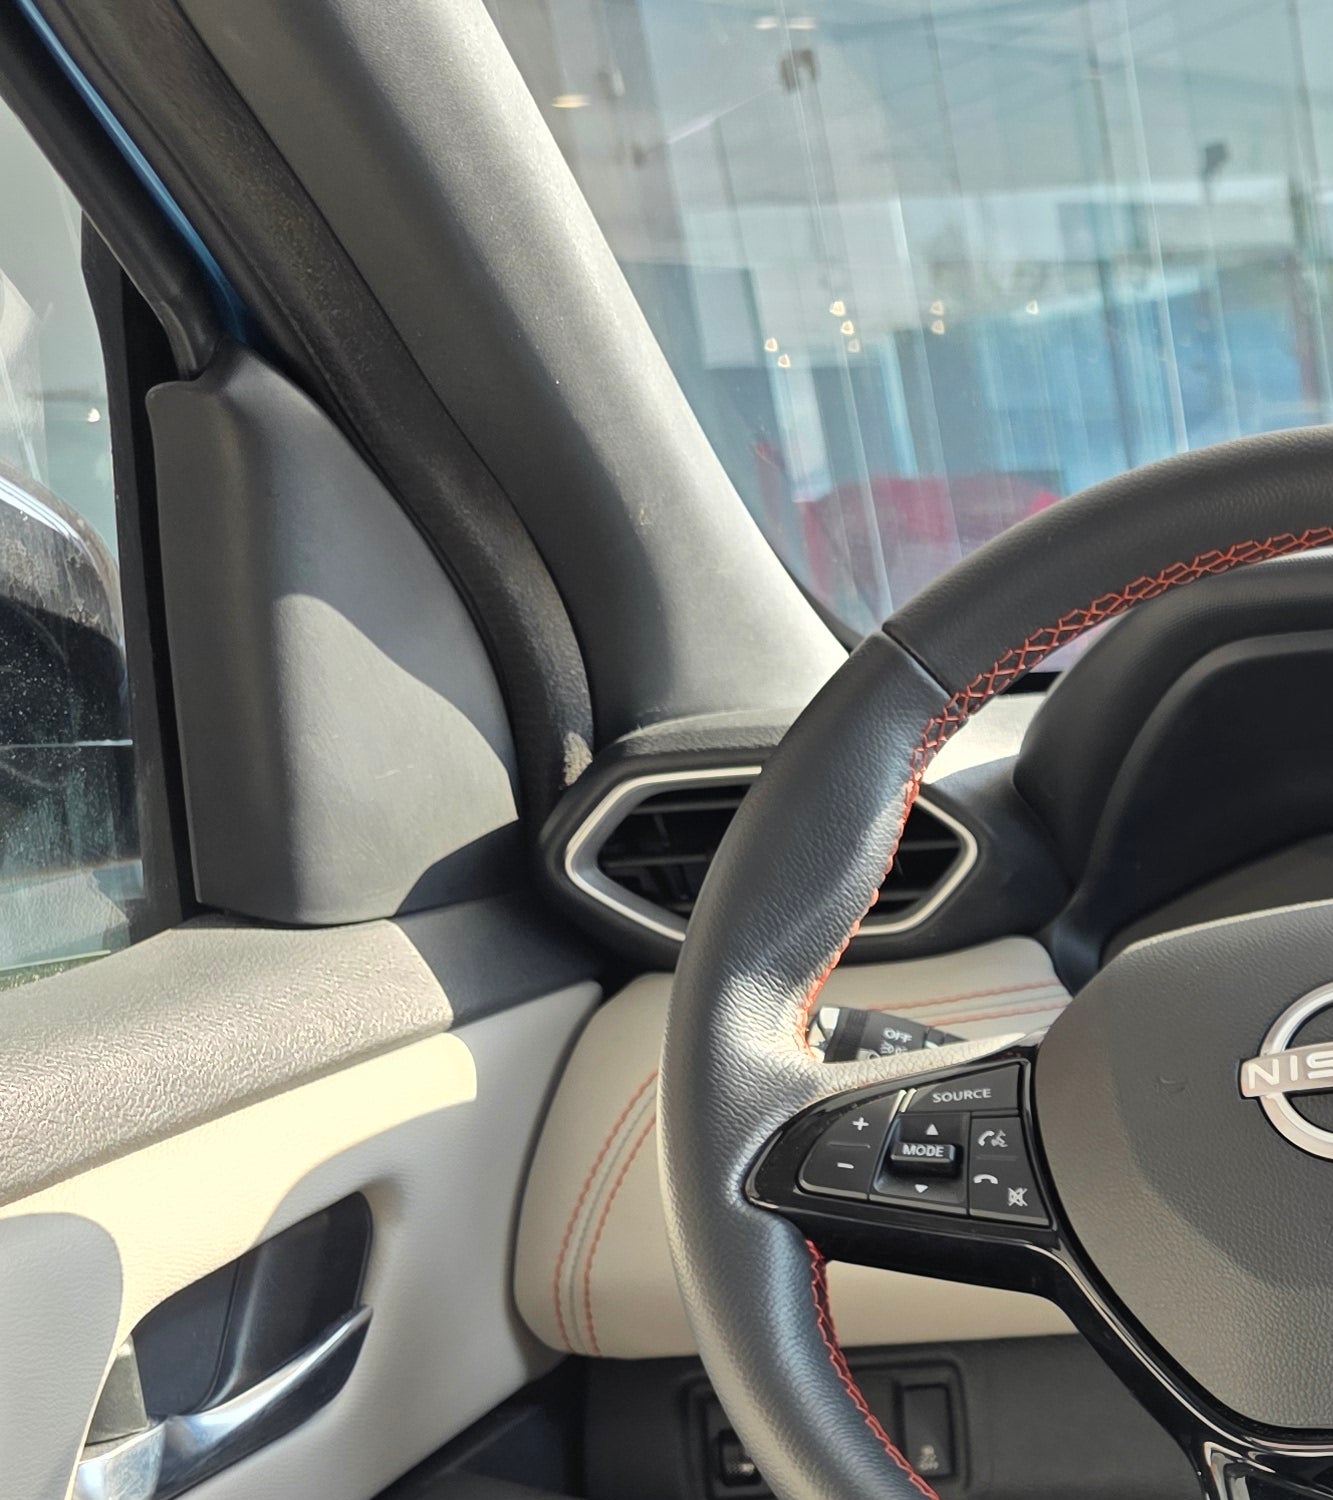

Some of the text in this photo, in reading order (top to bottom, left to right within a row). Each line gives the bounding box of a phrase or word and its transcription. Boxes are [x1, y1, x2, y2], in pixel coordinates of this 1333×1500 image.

[882, 1027, 913, 1043] OFF
[932, 1088, 992, 1103] SOURCE
[902, 1143, 945, 1157] MODE
